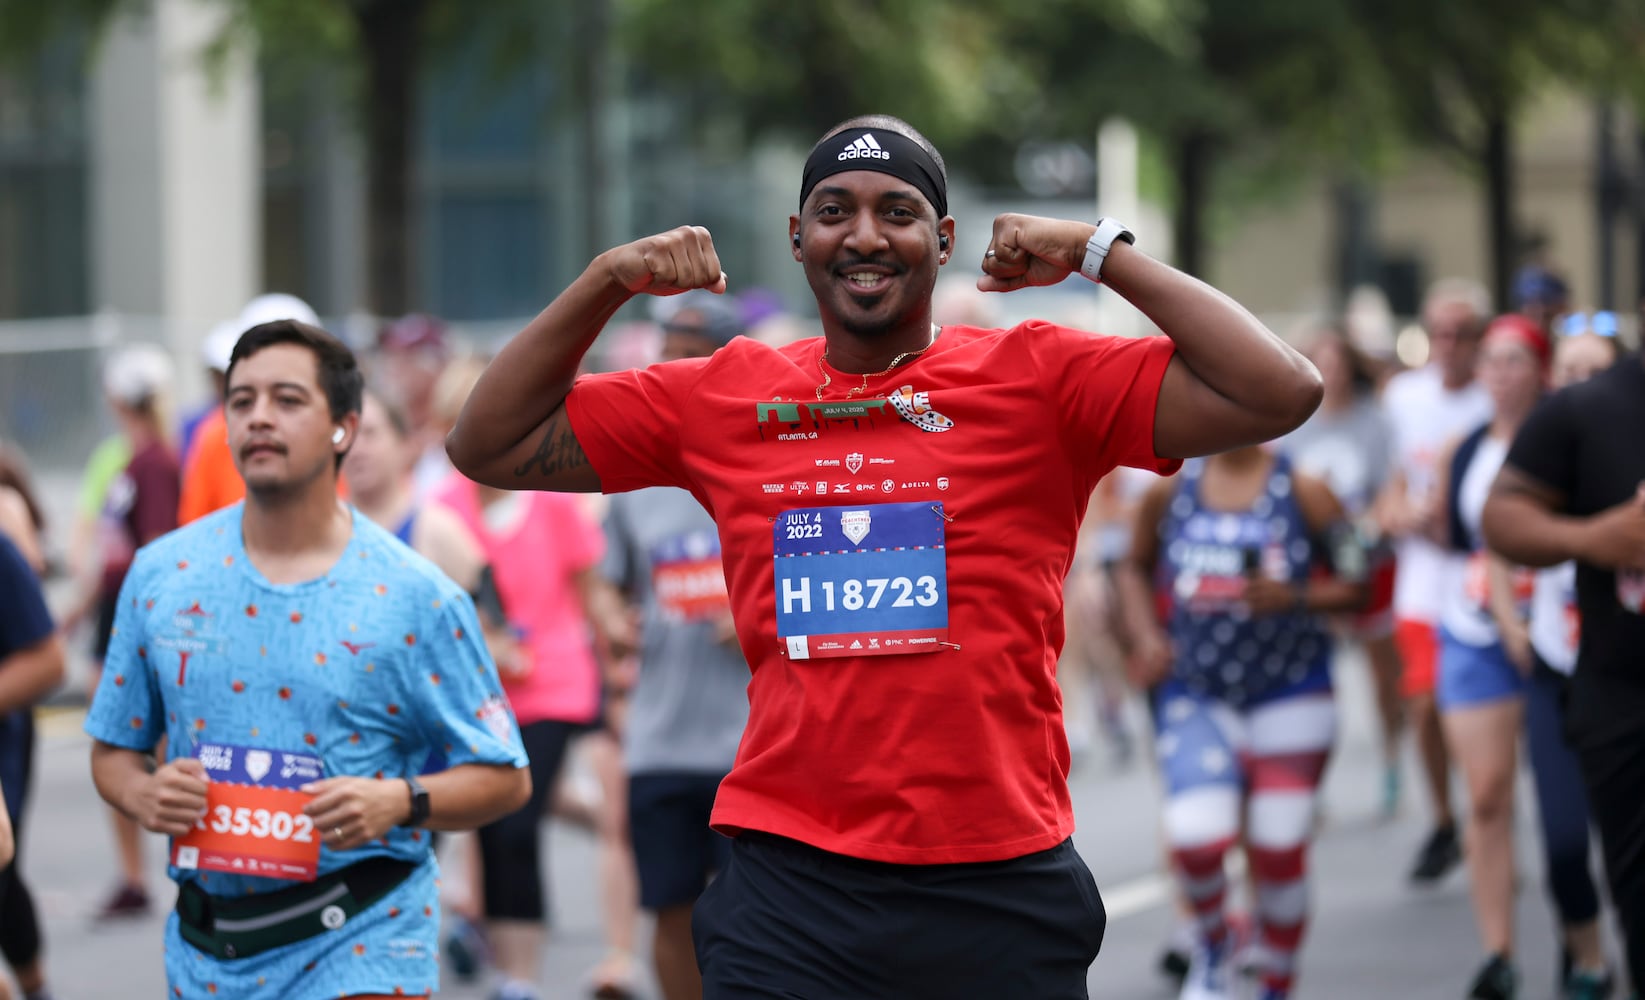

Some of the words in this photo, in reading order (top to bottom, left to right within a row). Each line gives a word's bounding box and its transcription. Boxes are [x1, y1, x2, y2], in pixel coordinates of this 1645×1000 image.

[837, 147, 890, 161] adidas
[777, 432, 808, 441] ATLANTA,
[786, 513, 810, 526] JULY
[814, 512, 822, 524] 4
[786, 524, 823, 540] 2022
[782, 577, 812, 614] H
[822, 575, 939, 611] 18723
[795, 642, 801, 651] L
[211, 804, 316, 842] 35302
